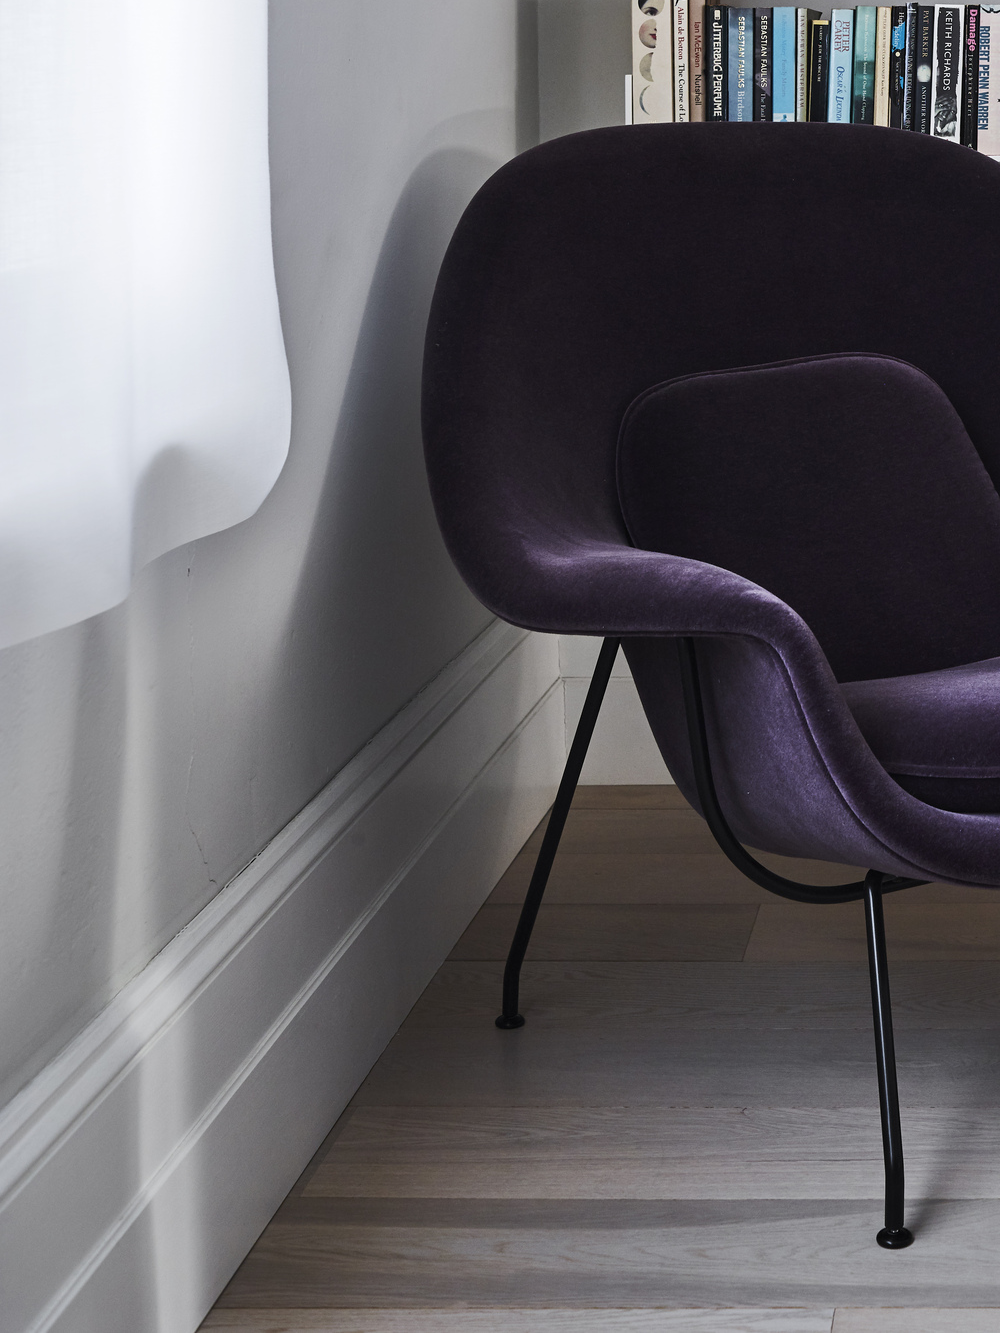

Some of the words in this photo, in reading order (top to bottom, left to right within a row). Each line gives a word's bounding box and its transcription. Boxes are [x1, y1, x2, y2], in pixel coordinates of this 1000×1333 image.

[713, 23, 722, 71] JITTERBUG
[967, 9, 978, 51] Damage
[979, 26, 990, 62] ROBERT
[943, 43, 951, 91] RICHARDS
[979, 65, 990, 89] PENN
[713, 75, 722, 116] PERFUME
[978, 92, 989, 130] WARREN
